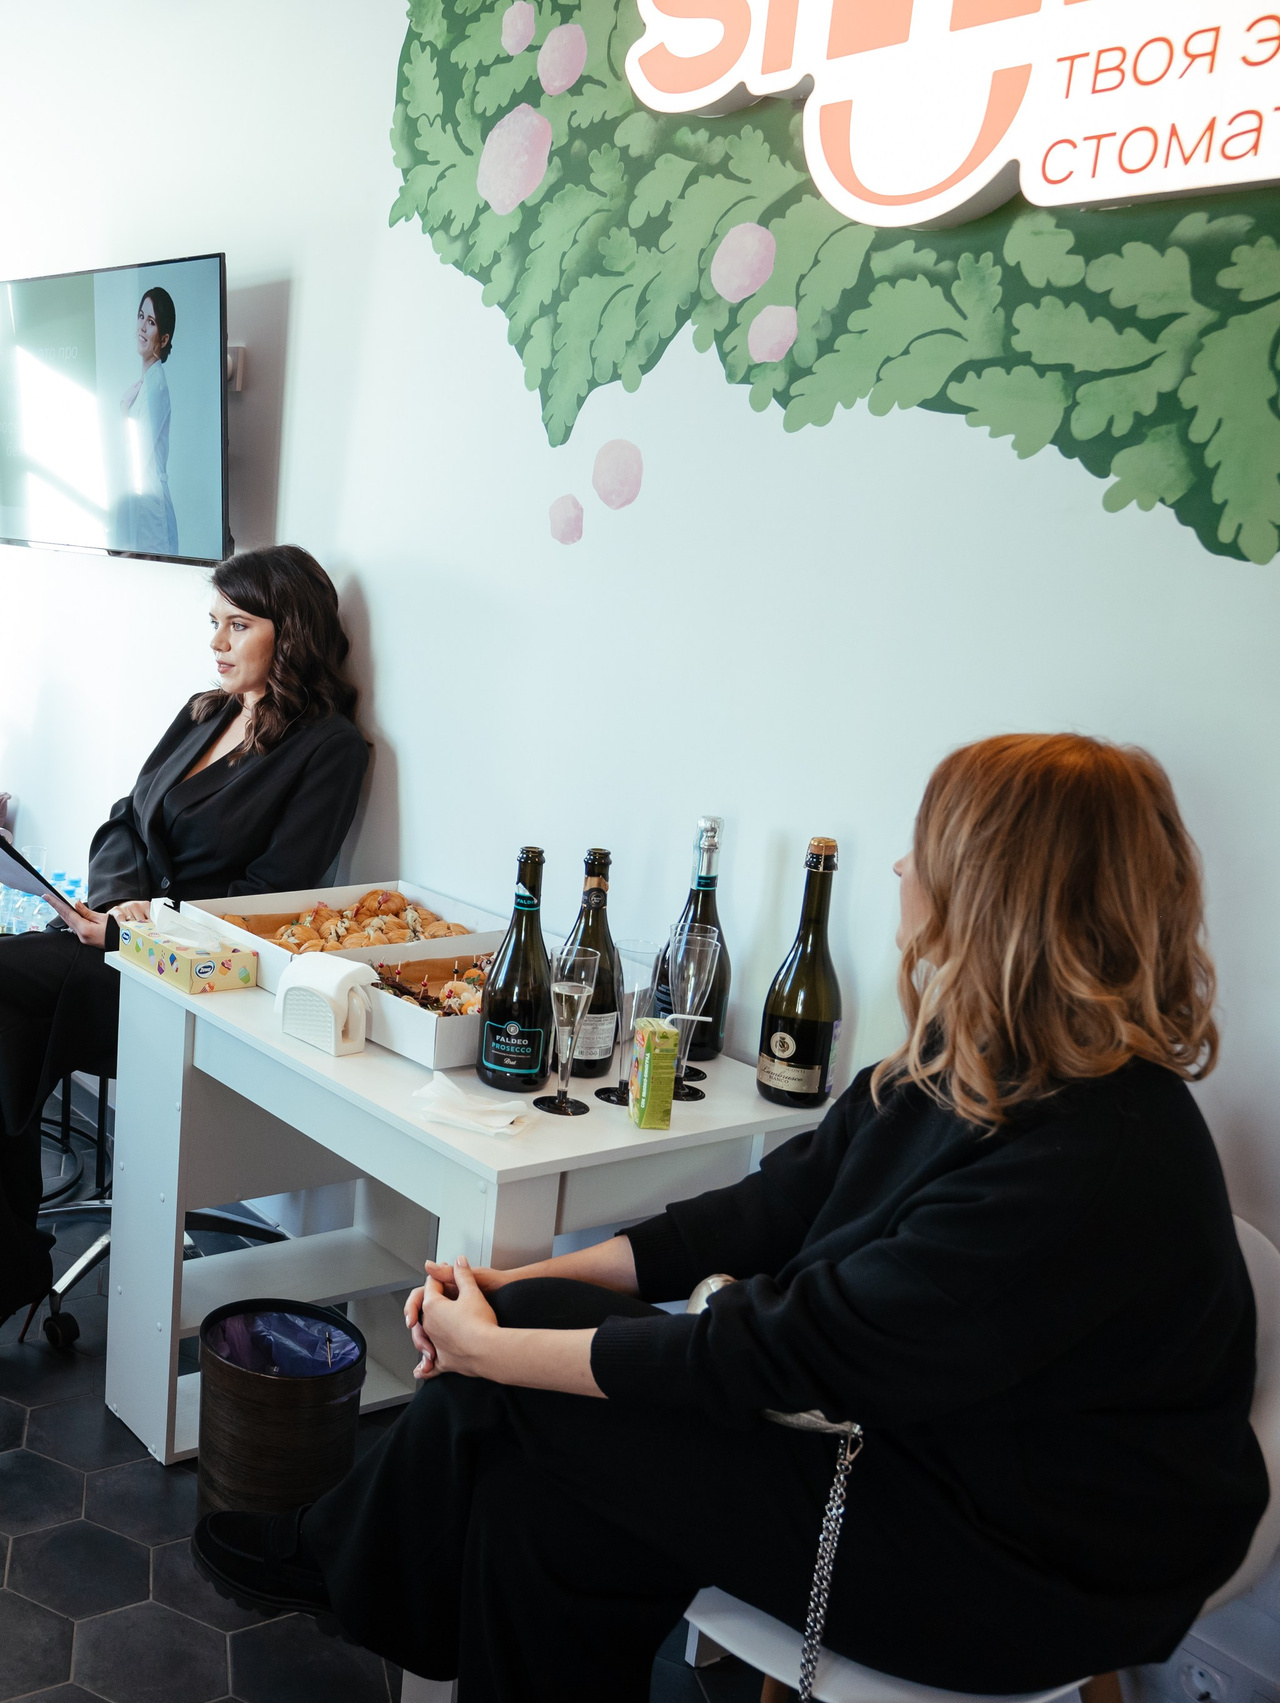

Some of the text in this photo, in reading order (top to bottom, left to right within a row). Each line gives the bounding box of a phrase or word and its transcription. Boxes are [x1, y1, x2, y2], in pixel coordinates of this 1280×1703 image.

[516, 897, 536, 905] FALD
[495, 1035, 529, 1045] FALDEO
[491, 1041, 532, 1053] PROSECCO
